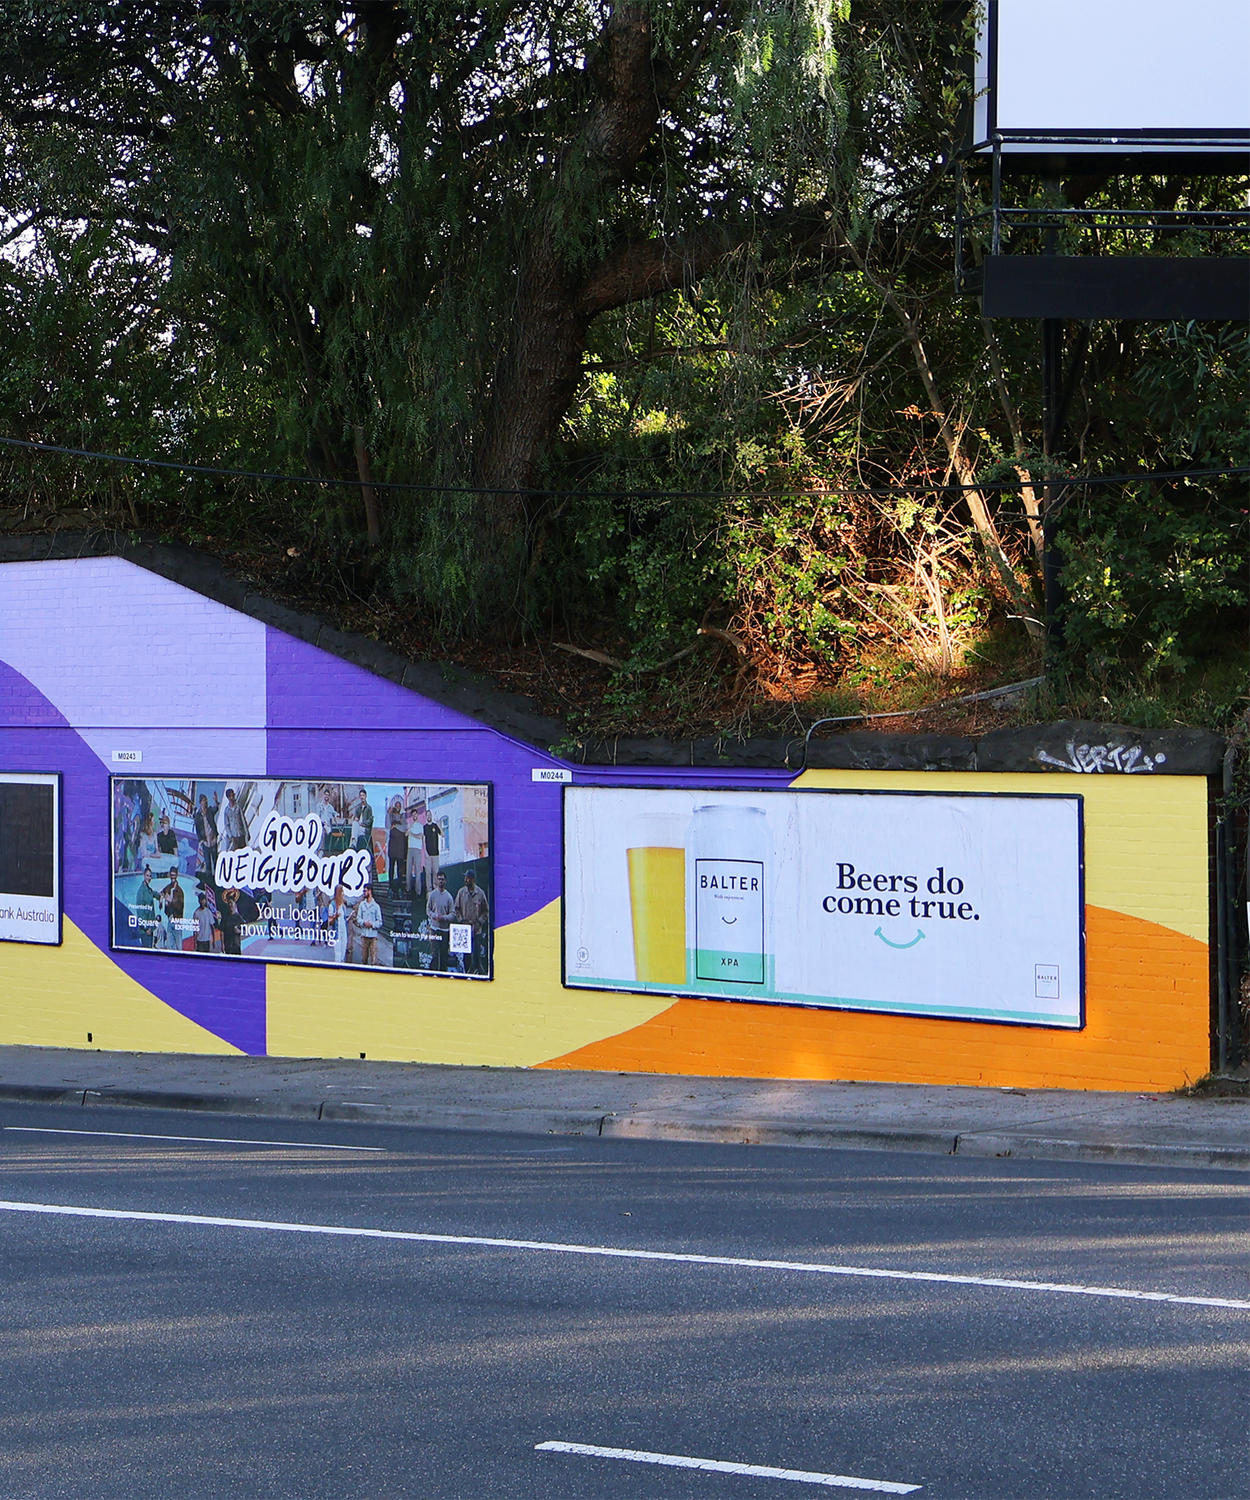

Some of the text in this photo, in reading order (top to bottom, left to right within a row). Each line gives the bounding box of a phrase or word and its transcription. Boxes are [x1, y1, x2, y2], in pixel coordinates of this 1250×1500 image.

[118, 752, 136, 760] M0243
[541, 771, 563, 779] M0244
[263, 817, 318, 851] GOOD
[219, 852, 366, 890] NEIGHBOURS
[700, 875, 758, 891] BALTER
[836, 862, 964, 895] Beers do
[128, 903, 153, 912] Presented by
[255, 902, 323, 925] Your local,
[822, 895, 980, 921] come true.
[16, 907, 54, 922] Australia
[170, 917, 200, 925] AMERICAN
[138, 917, 159, 928] Square
[174, 923, 200, 931] EXPRESS
[240, 924, 340, 947] now streaming.
[389, 930, 401, 938] Scan
[429, 933, 443, 941] series
[721, 957, 739, 967] XPA
